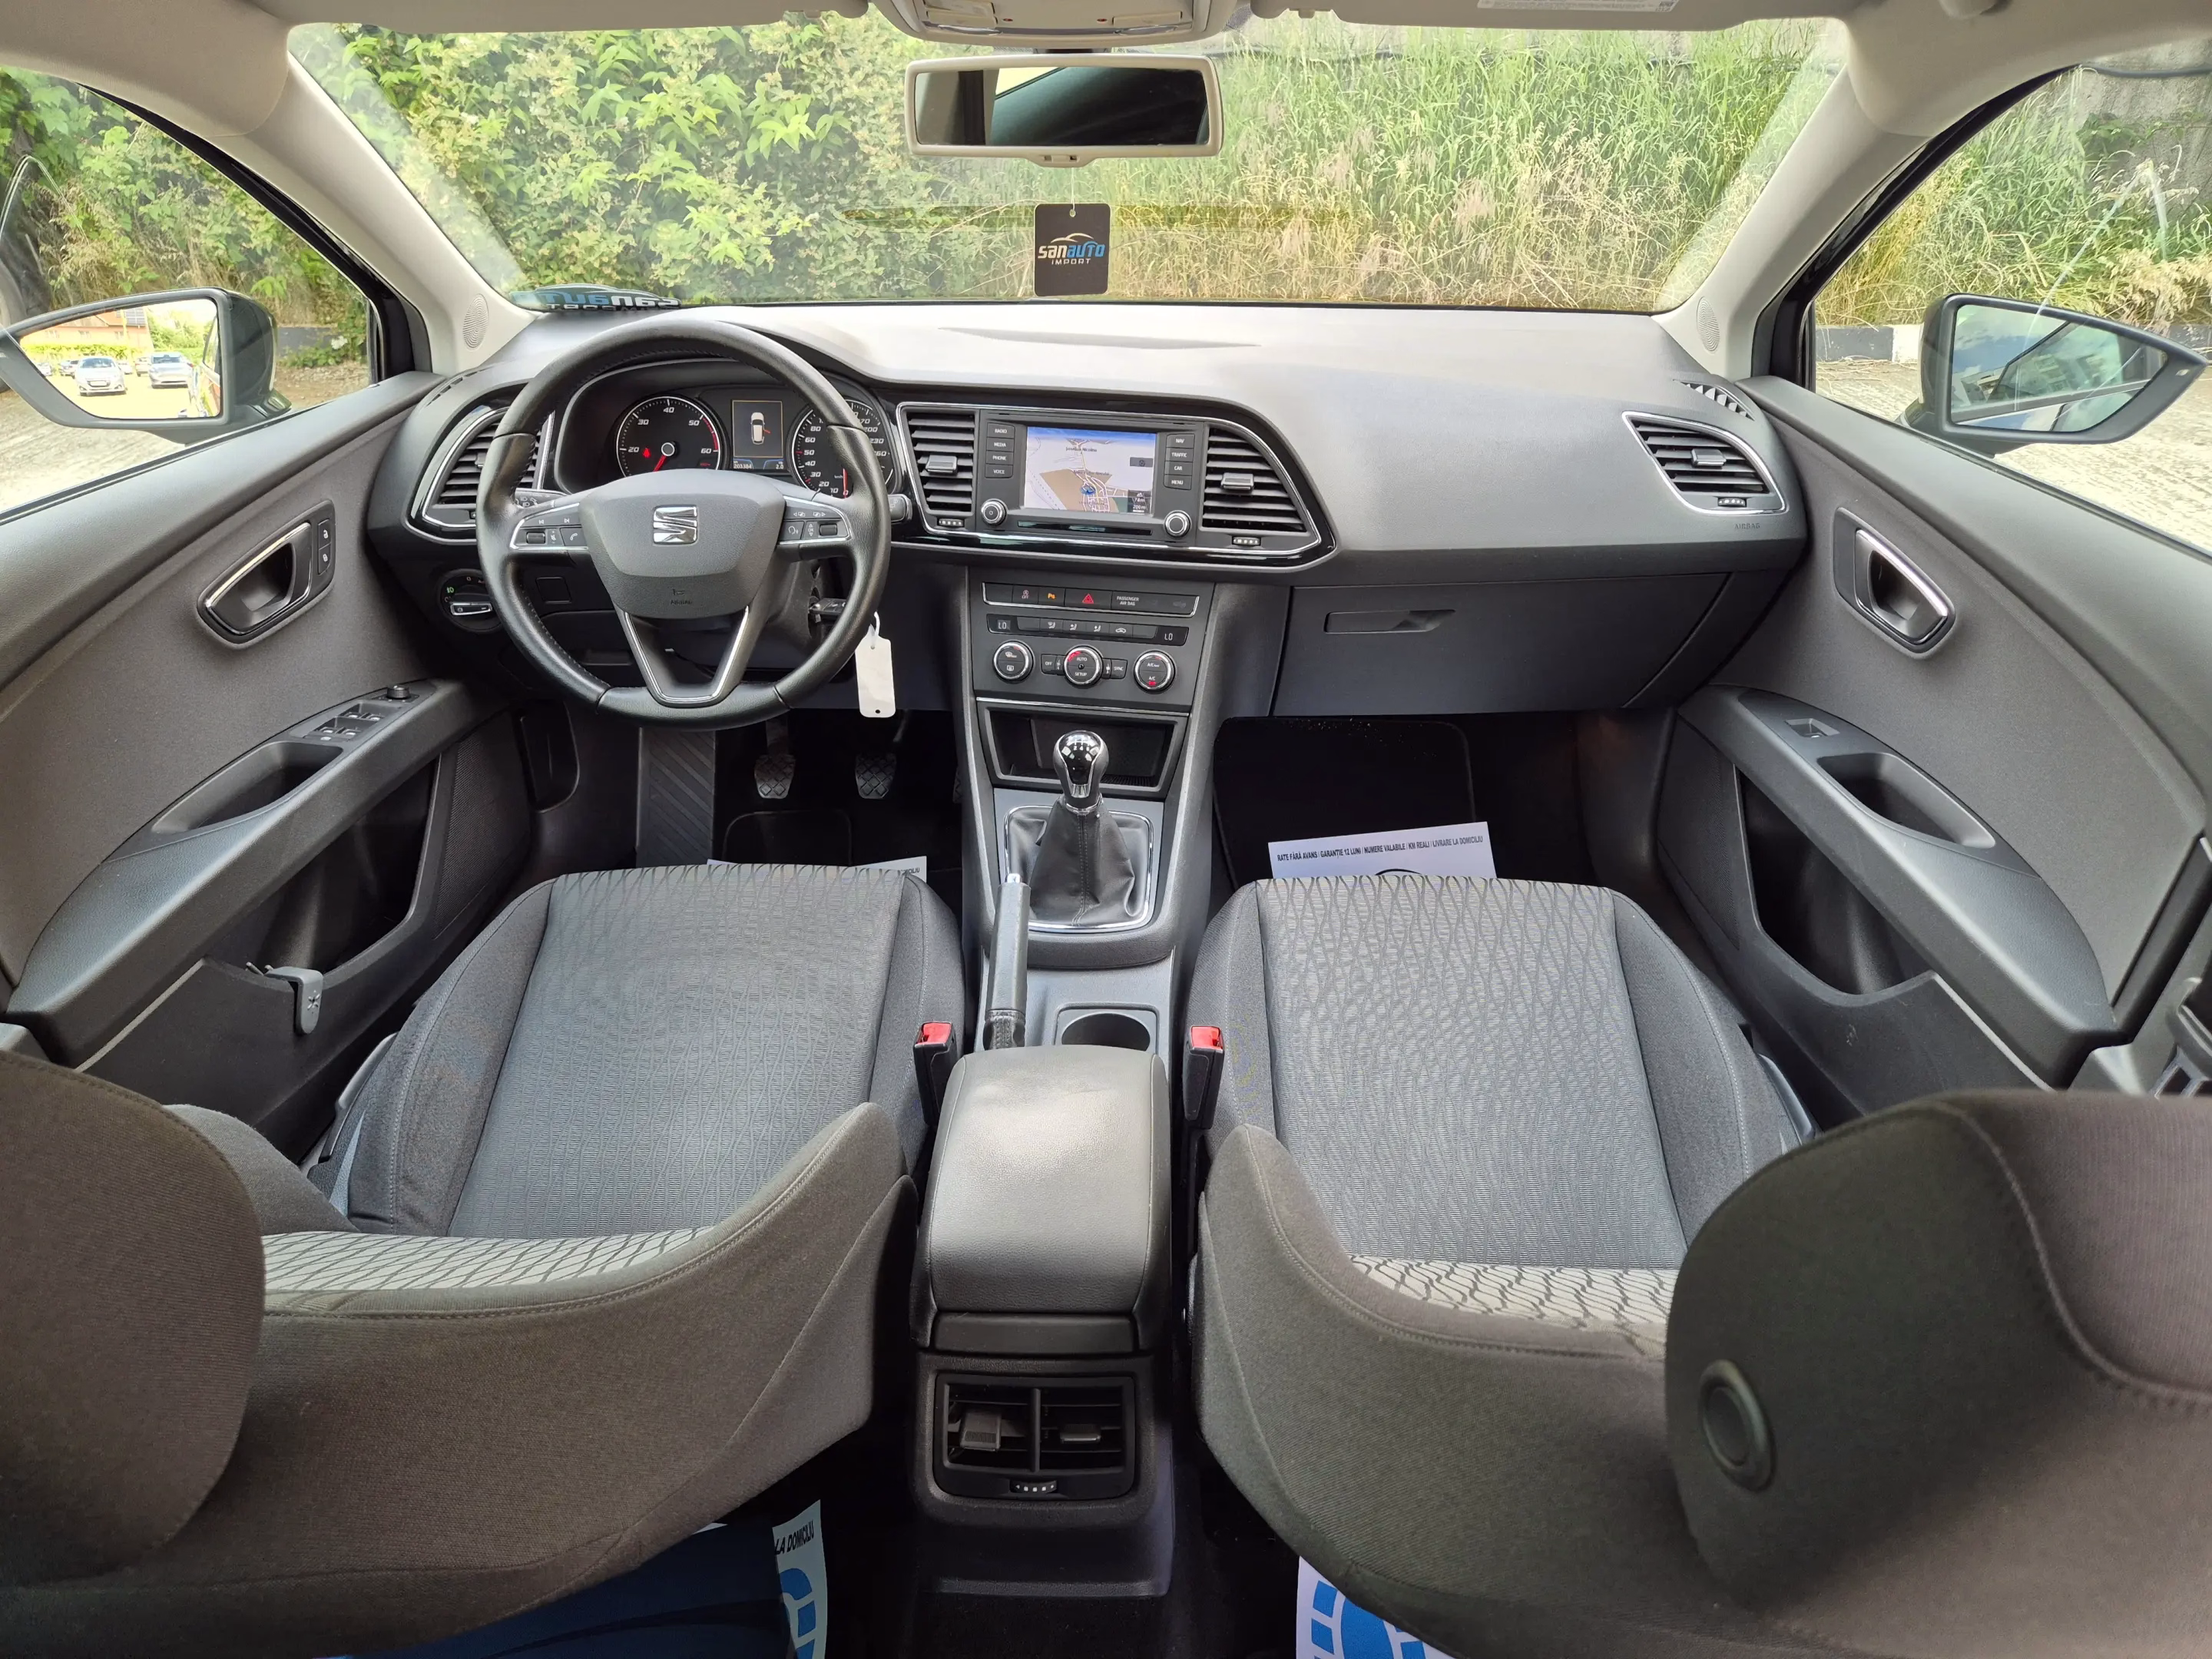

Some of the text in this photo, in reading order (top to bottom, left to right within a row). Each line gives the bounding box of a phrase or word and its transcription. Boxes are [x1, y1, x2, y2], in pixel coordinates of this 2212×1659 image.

[1277, 853, 1290, 862] RATE
[1303, 851, 1318, 859] AVANS
[1364, 844, 1383, 853] NUMERE
[1383, 843, 1406, 852] VALABILE
[1416, 840, 1430, 849] REALI
[1432, 839, 1452, 847] LIVRARE
[1459, 836, 1483, 845] DOMICILIU
[775, 1520, 814, 1555] LA DOMICILIU
